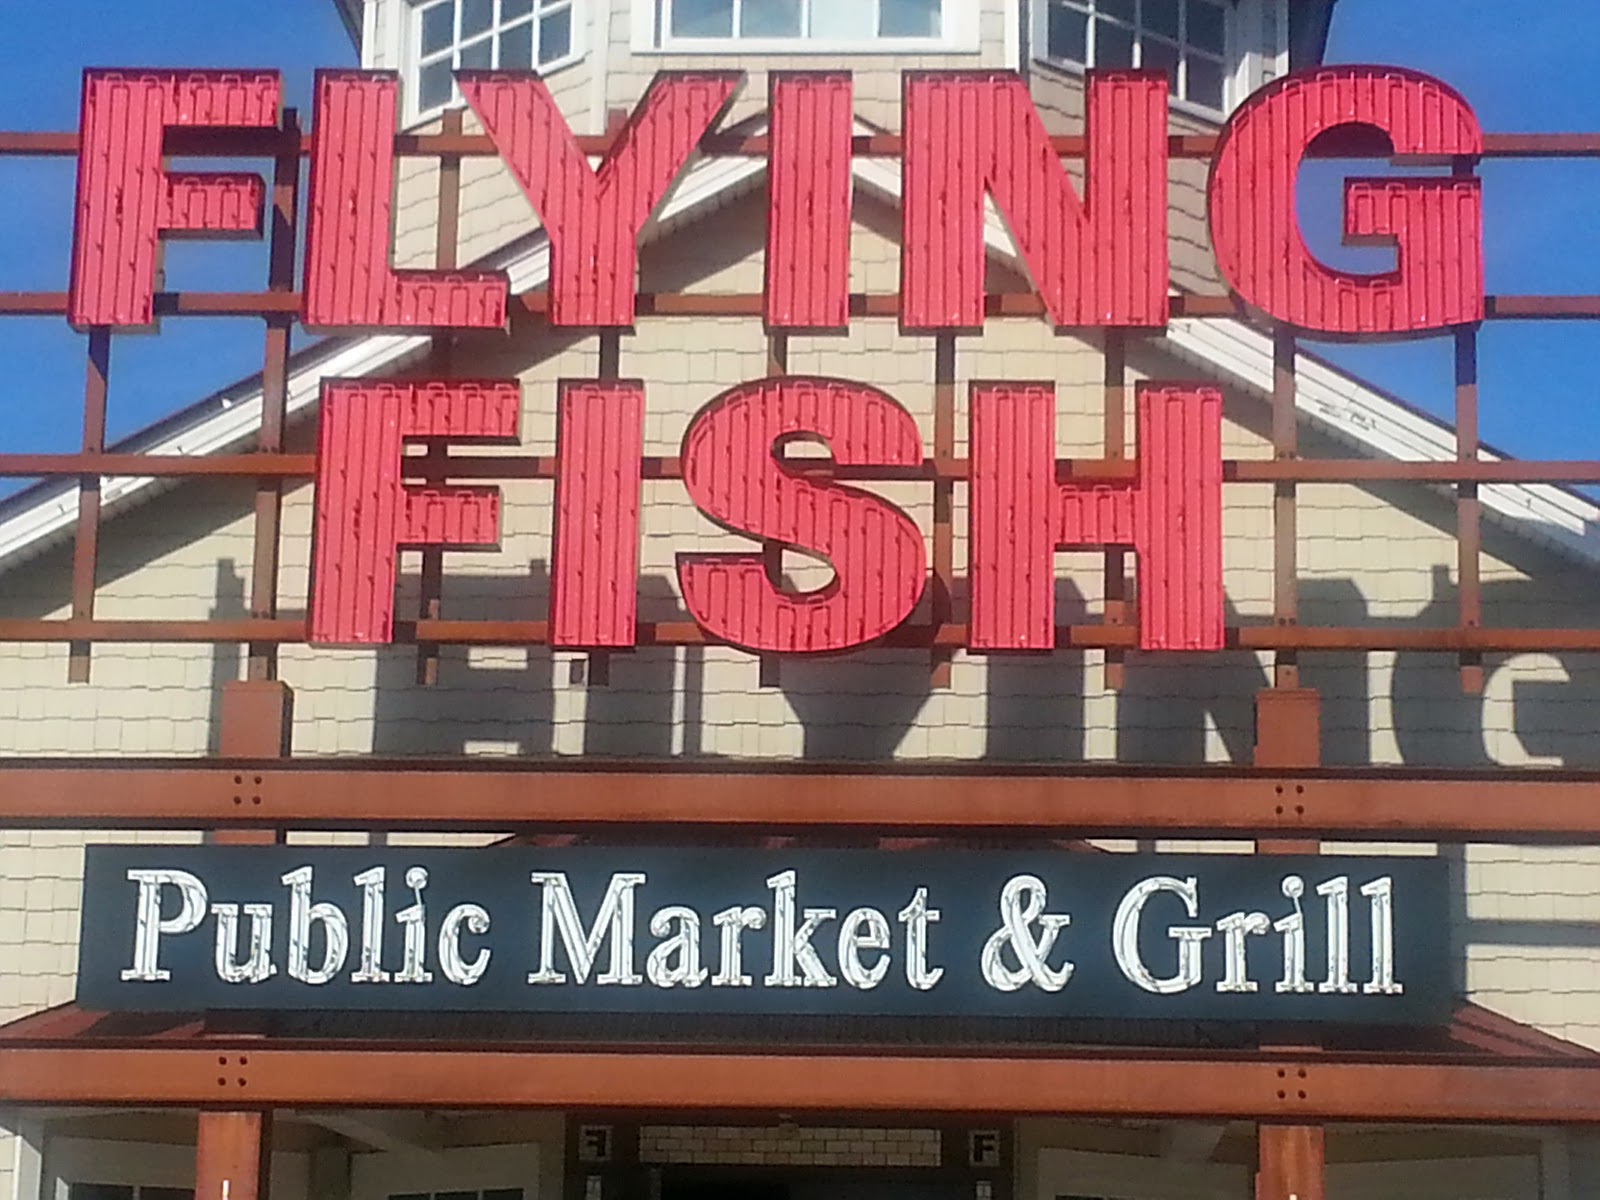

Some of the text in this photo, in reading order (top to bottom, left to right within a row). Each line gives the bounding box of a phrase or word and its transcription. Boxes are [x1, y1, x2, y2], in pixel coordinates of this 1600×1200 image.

[68, 66, 1484, 341] FLYING
[306, 377, 1226, 655] FISH
[120, 865, 1406, 996] Public Market & Grill
[973, 1134, 995, 1162] F
